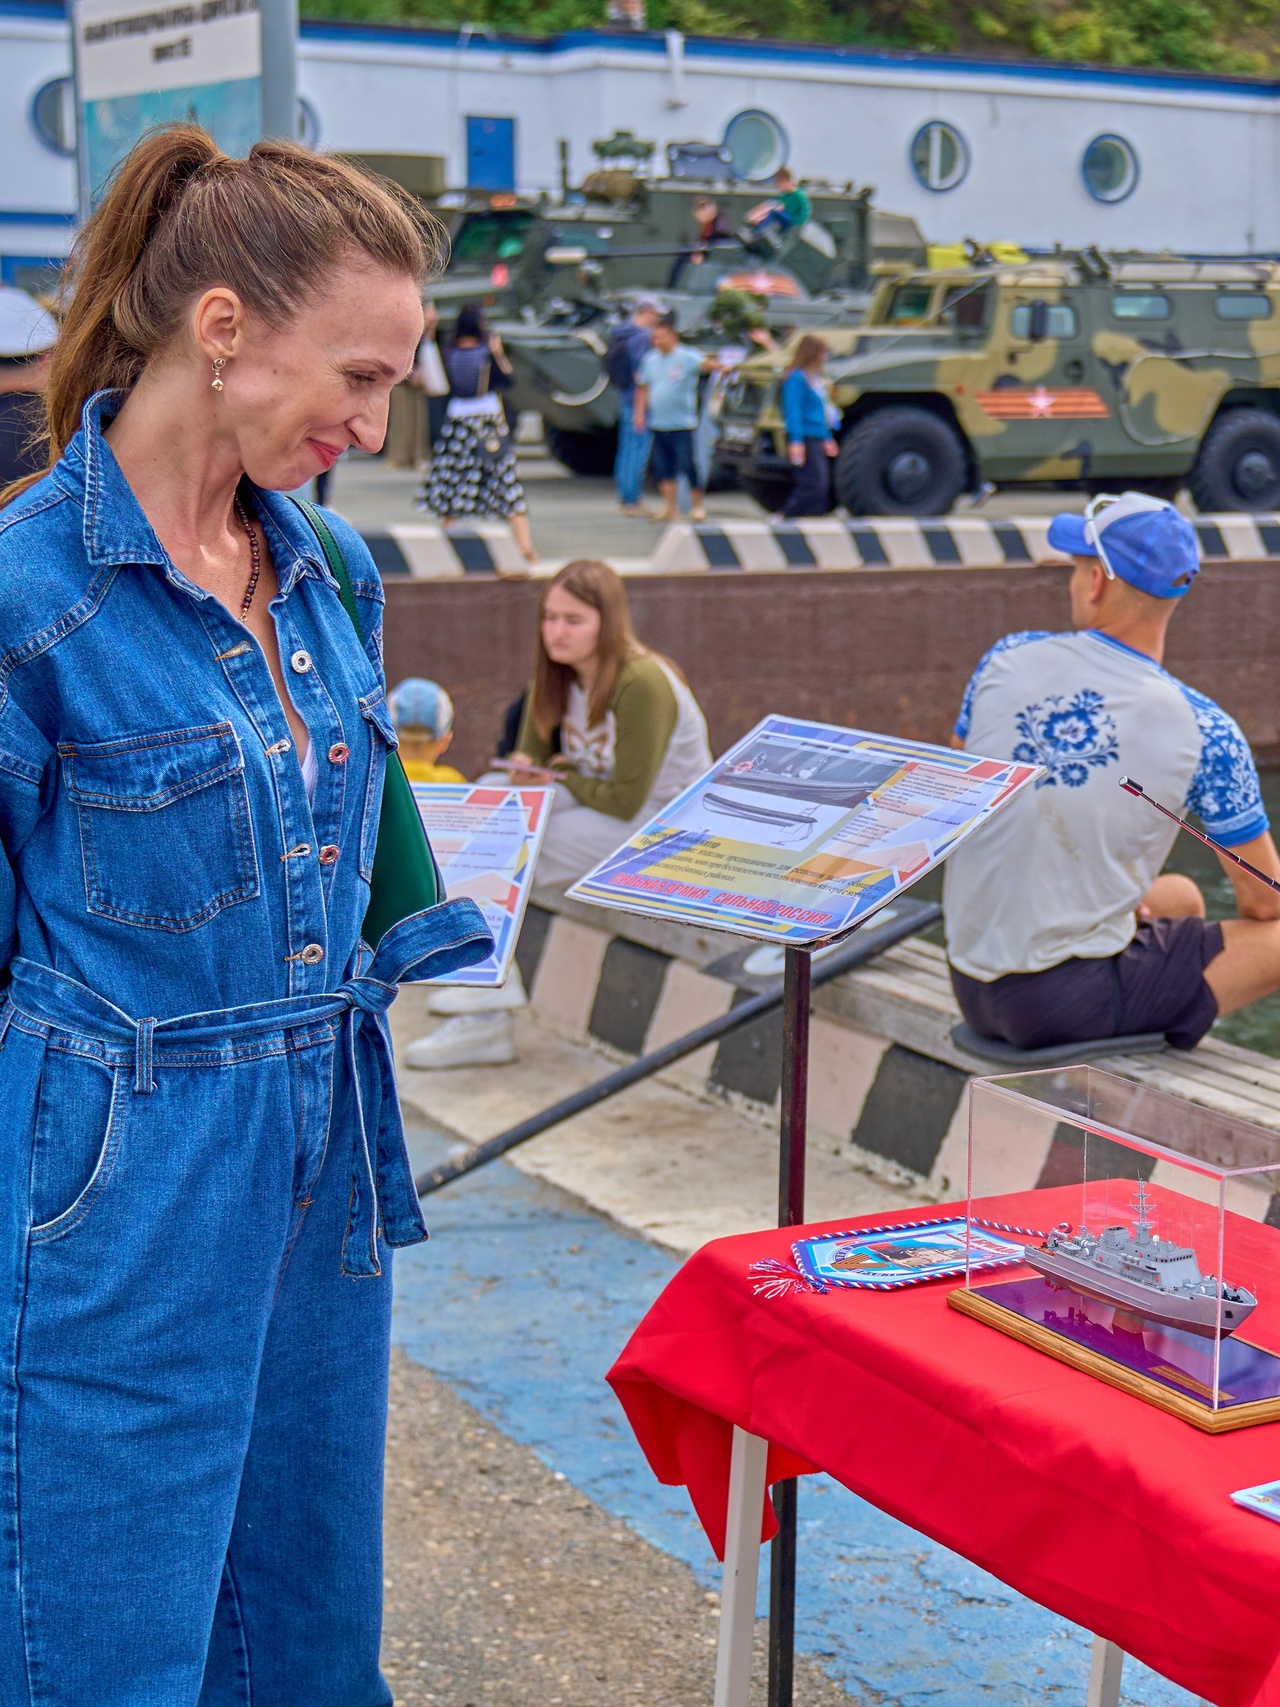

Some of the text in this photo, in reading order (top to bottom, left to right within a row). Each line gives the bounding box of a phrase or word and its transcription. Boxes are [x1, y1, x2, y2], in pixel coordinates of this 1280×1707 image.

[609, 872, 668, 893] СИЛЬНАЯ
[664, 882, 712, 900] АРМИЯ
[711, 892, 777, 915] СИЛЬНАЯ
[770, 904, 834, 926] РОССИЯ!
